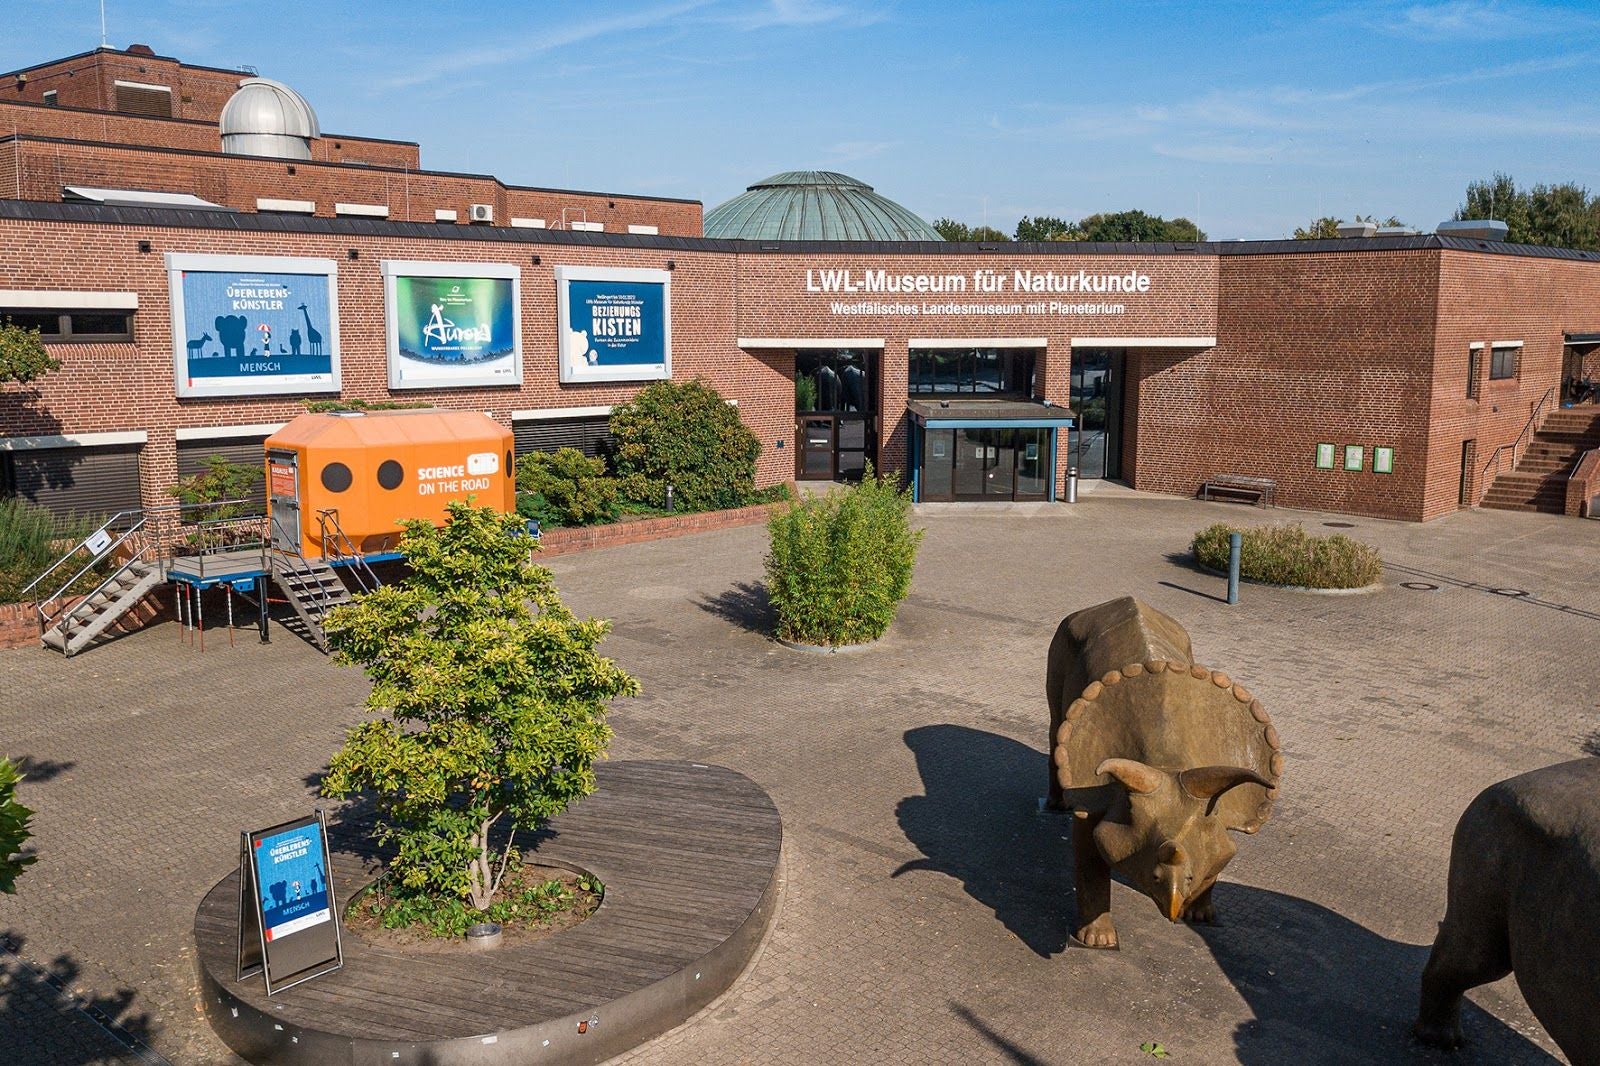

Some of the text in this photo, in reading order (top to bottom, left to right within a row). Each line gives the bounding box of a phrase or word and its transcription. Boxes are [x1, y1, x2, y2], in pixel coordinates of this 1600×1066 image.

[806, 269, 1150, 292] LWL-Museum für Naturkunde
[226, 286, 292, 298] ÜBERLEBENS-
[232, 298, 284, 310] KÜNSTLER
[830, 302, 1125, 315] Westfälisches Landesmuseum mit Planetarium
[592, 305, 641, 318] BEZIEHUNGS
[592, 318, 641, 337] KISTEN
[239, 362, 281, 372] MENSCH
[417, 464, 465, 480] SCIENCE
[418, 478, 490, 495] ON THE ROAD
[282, 901, 310, 916] MENSCH
